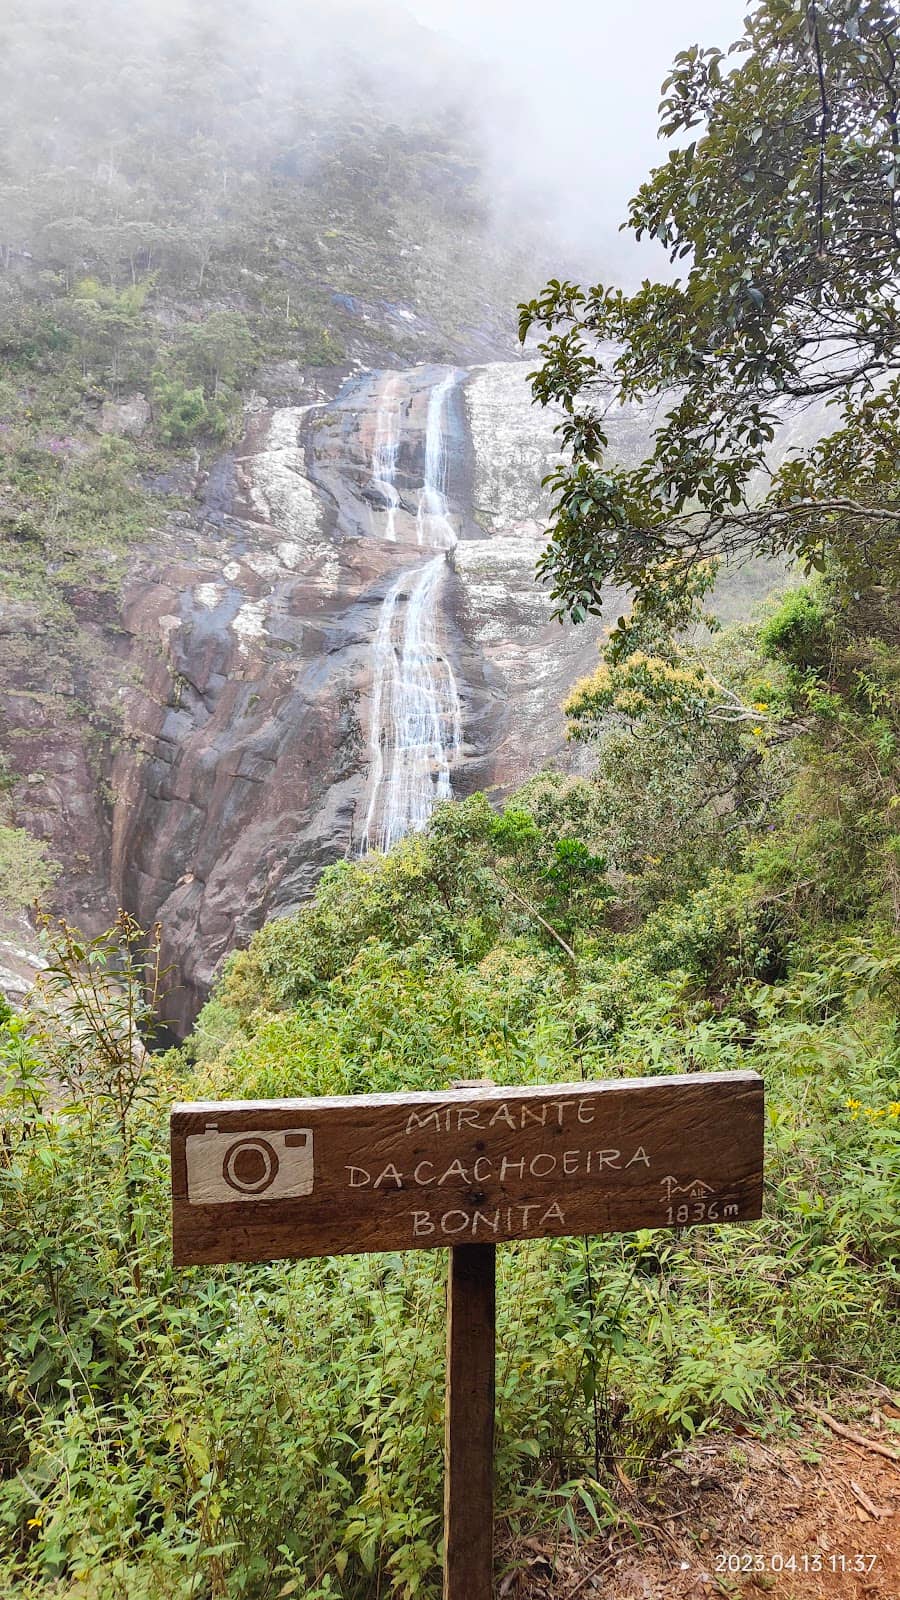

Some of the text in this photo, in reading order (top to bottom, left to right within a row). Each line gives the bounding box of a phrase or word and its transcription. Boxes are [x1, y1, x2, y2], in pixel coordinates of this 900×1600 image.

[405, 1099, 596, 1135] MIRANTE
[344, 1145, 651, 1189] DA CACHOEIRA
[410, 1202, 566, 1237] BONITA
